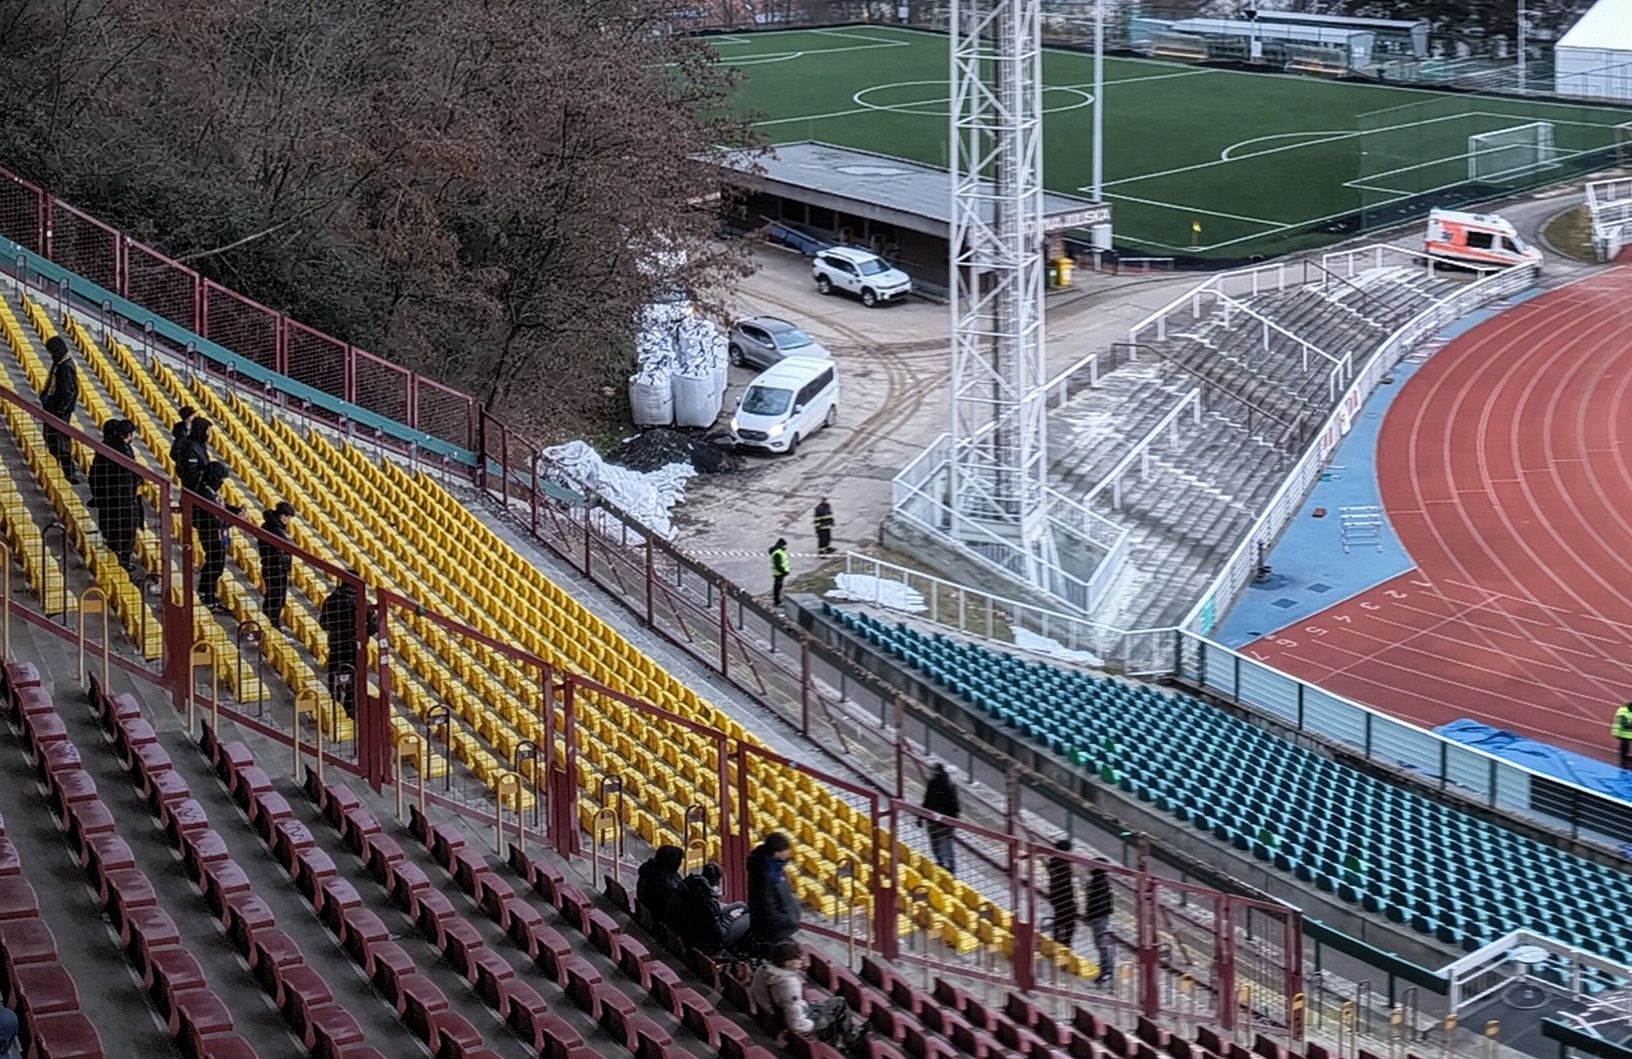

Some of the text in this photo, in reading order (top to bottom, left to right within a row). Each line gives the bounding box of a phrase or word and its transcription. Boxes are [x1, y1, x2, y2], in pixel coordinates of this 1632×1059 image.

[1383, 589, 1408, 599] 2
[1359, 601, 1381, 611] 3
[1305, 625, 1329, 636] 5
[1275, 638, 1298, 648] 6
[1251, 650, 1271, 662] 7
